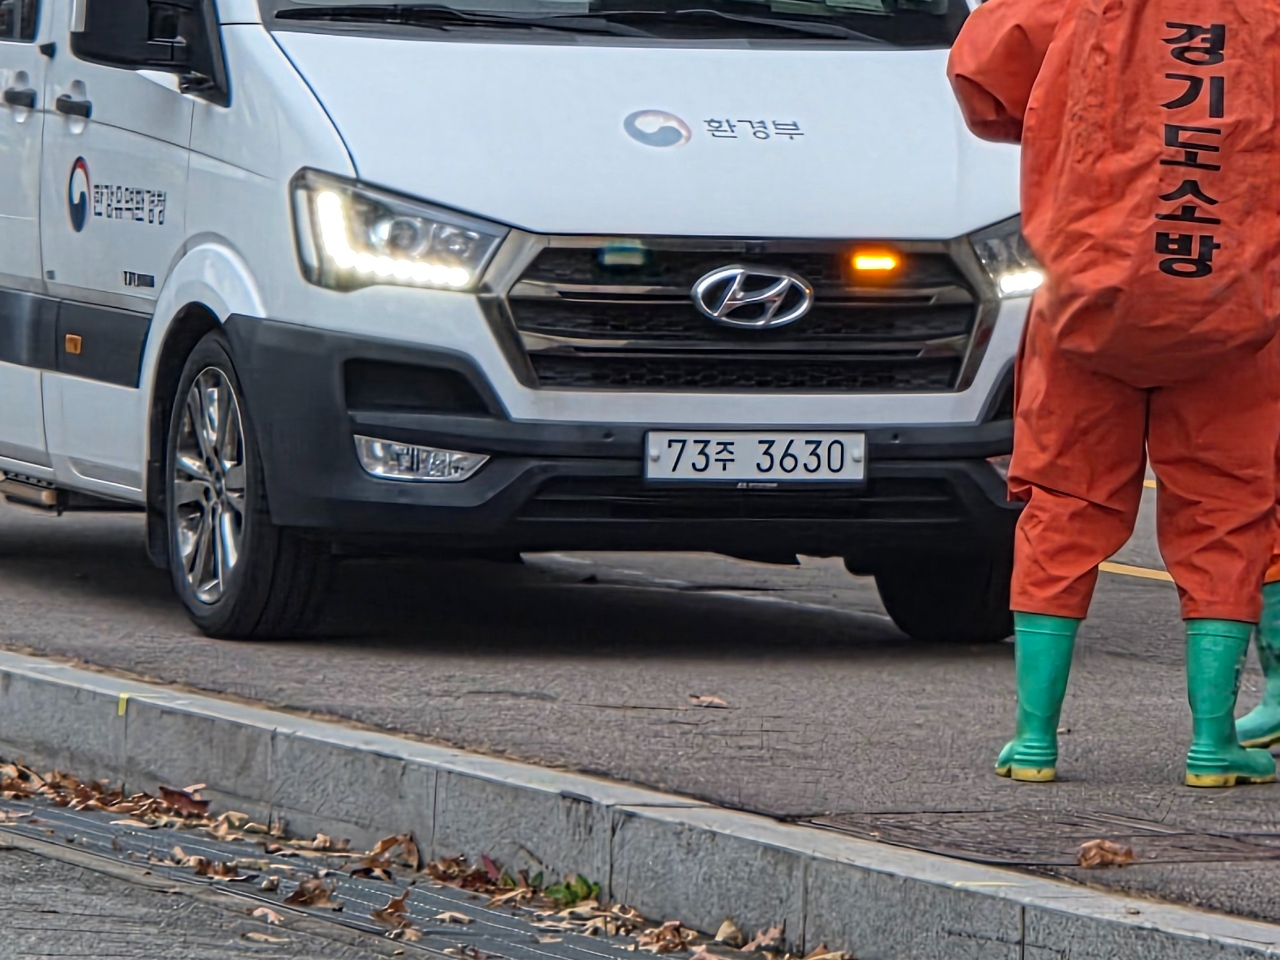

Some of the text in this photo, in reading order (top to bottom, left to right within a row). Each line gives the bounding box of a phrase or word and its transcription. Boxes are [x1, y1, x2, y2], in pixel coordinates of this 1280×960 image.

[703, 118, 805, 140] 환경부
[1154, 21, 1226, 279] 경기도소방
[667, 439, 845, 473] 73주 3630
